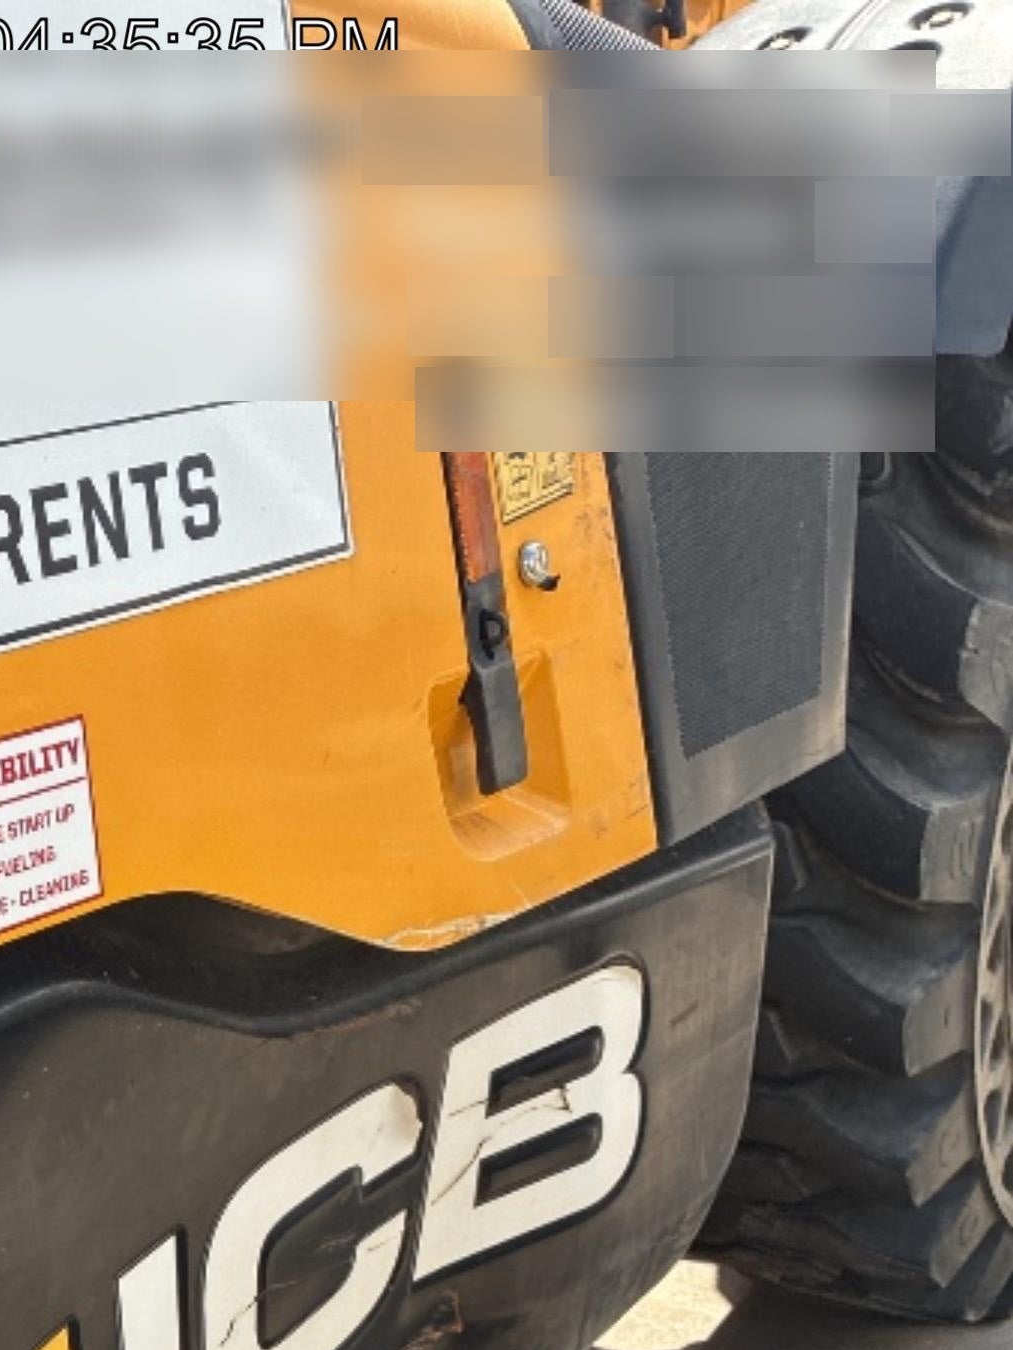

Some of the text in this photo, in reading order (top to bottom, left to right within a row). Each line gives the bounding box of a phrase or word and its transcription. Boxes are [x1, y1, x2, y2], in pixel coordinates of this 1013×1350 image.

[7, 810, 54, 840] START
[56, 803, 76, 824] UP
[19, 869, 90, 908] CLEANING
